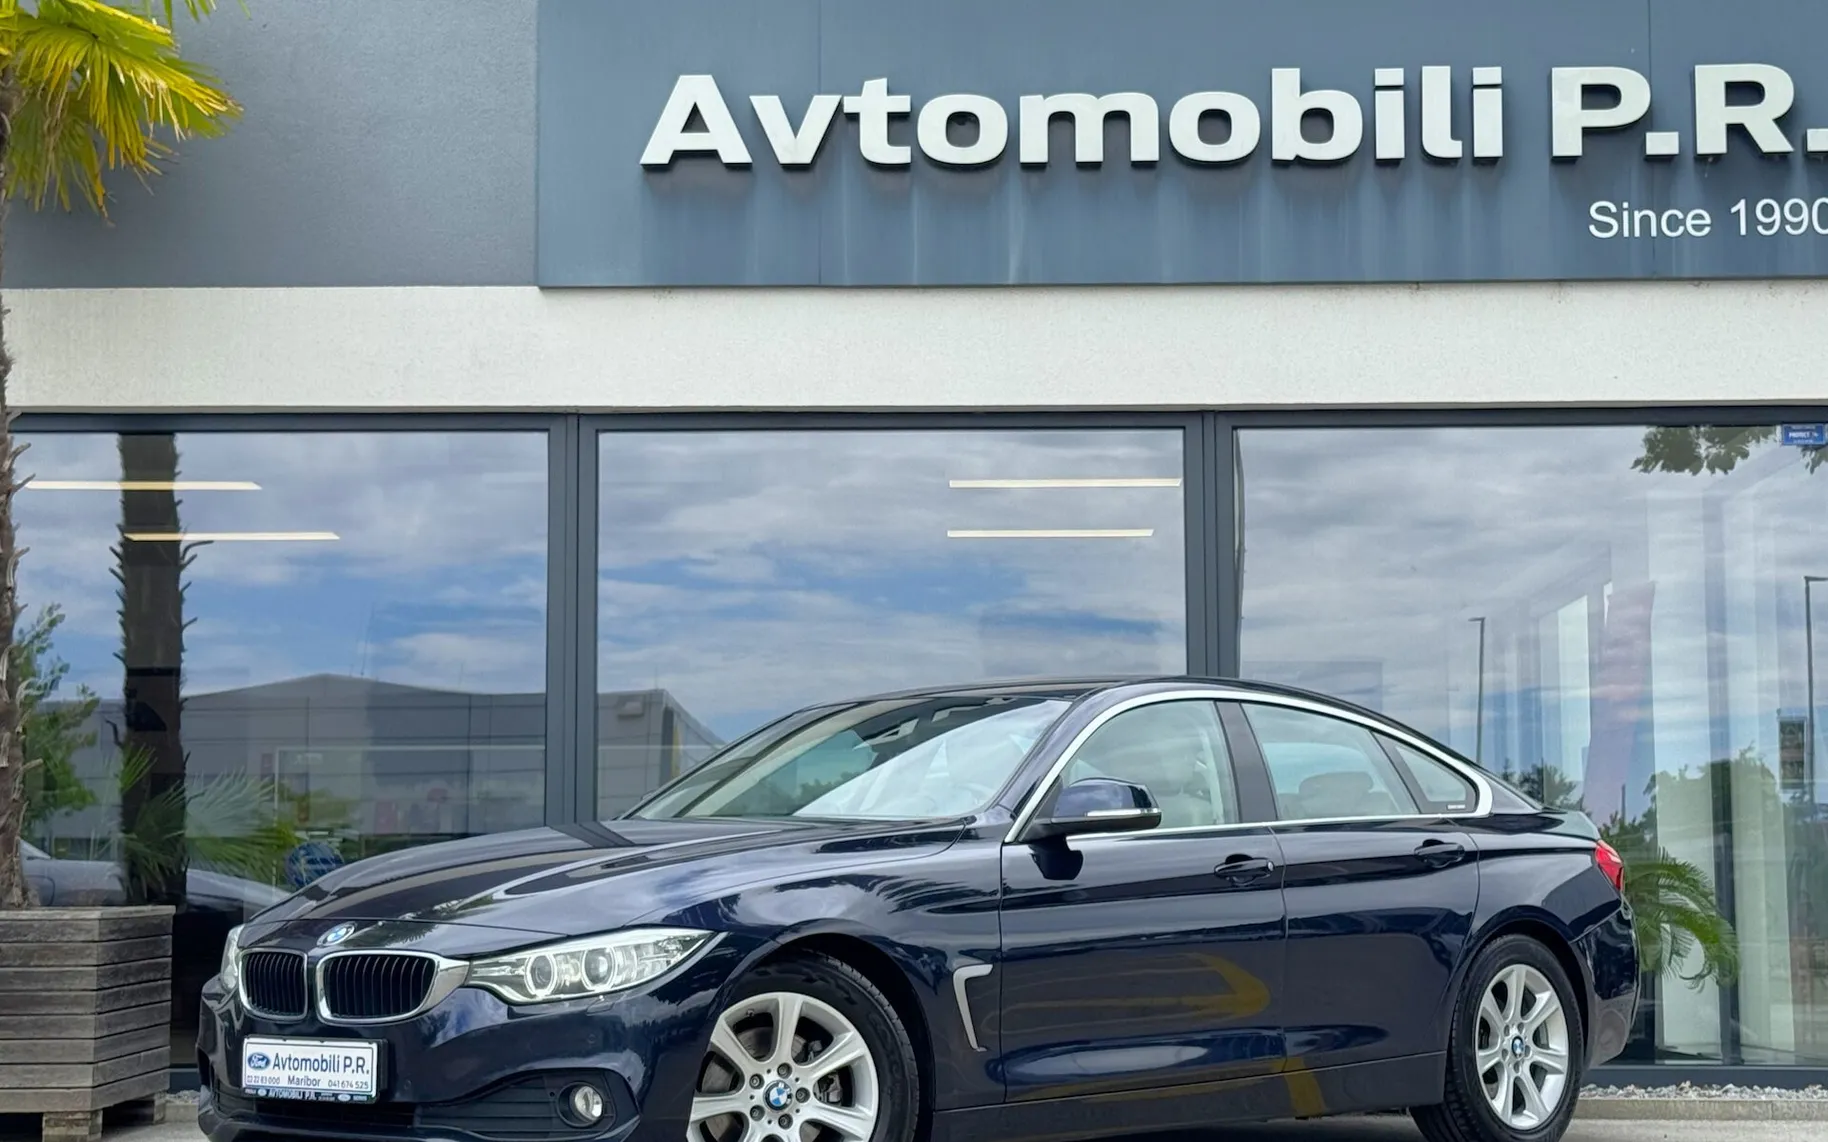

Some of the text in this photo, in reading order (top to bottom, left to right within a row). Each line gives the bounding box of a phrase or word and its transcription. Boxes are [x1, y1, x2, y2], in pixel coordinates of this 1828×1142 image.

[639, 62, 1828, 167] Avtomobili P.R.
[1588, 197, 1828, 238] Since 1990
[273, 1053, 370, 1075] Avtomobili P.R.
[287, 1075, 321, 1087] Maribor
[327, 1079, 369, 1089] 041 674 525
